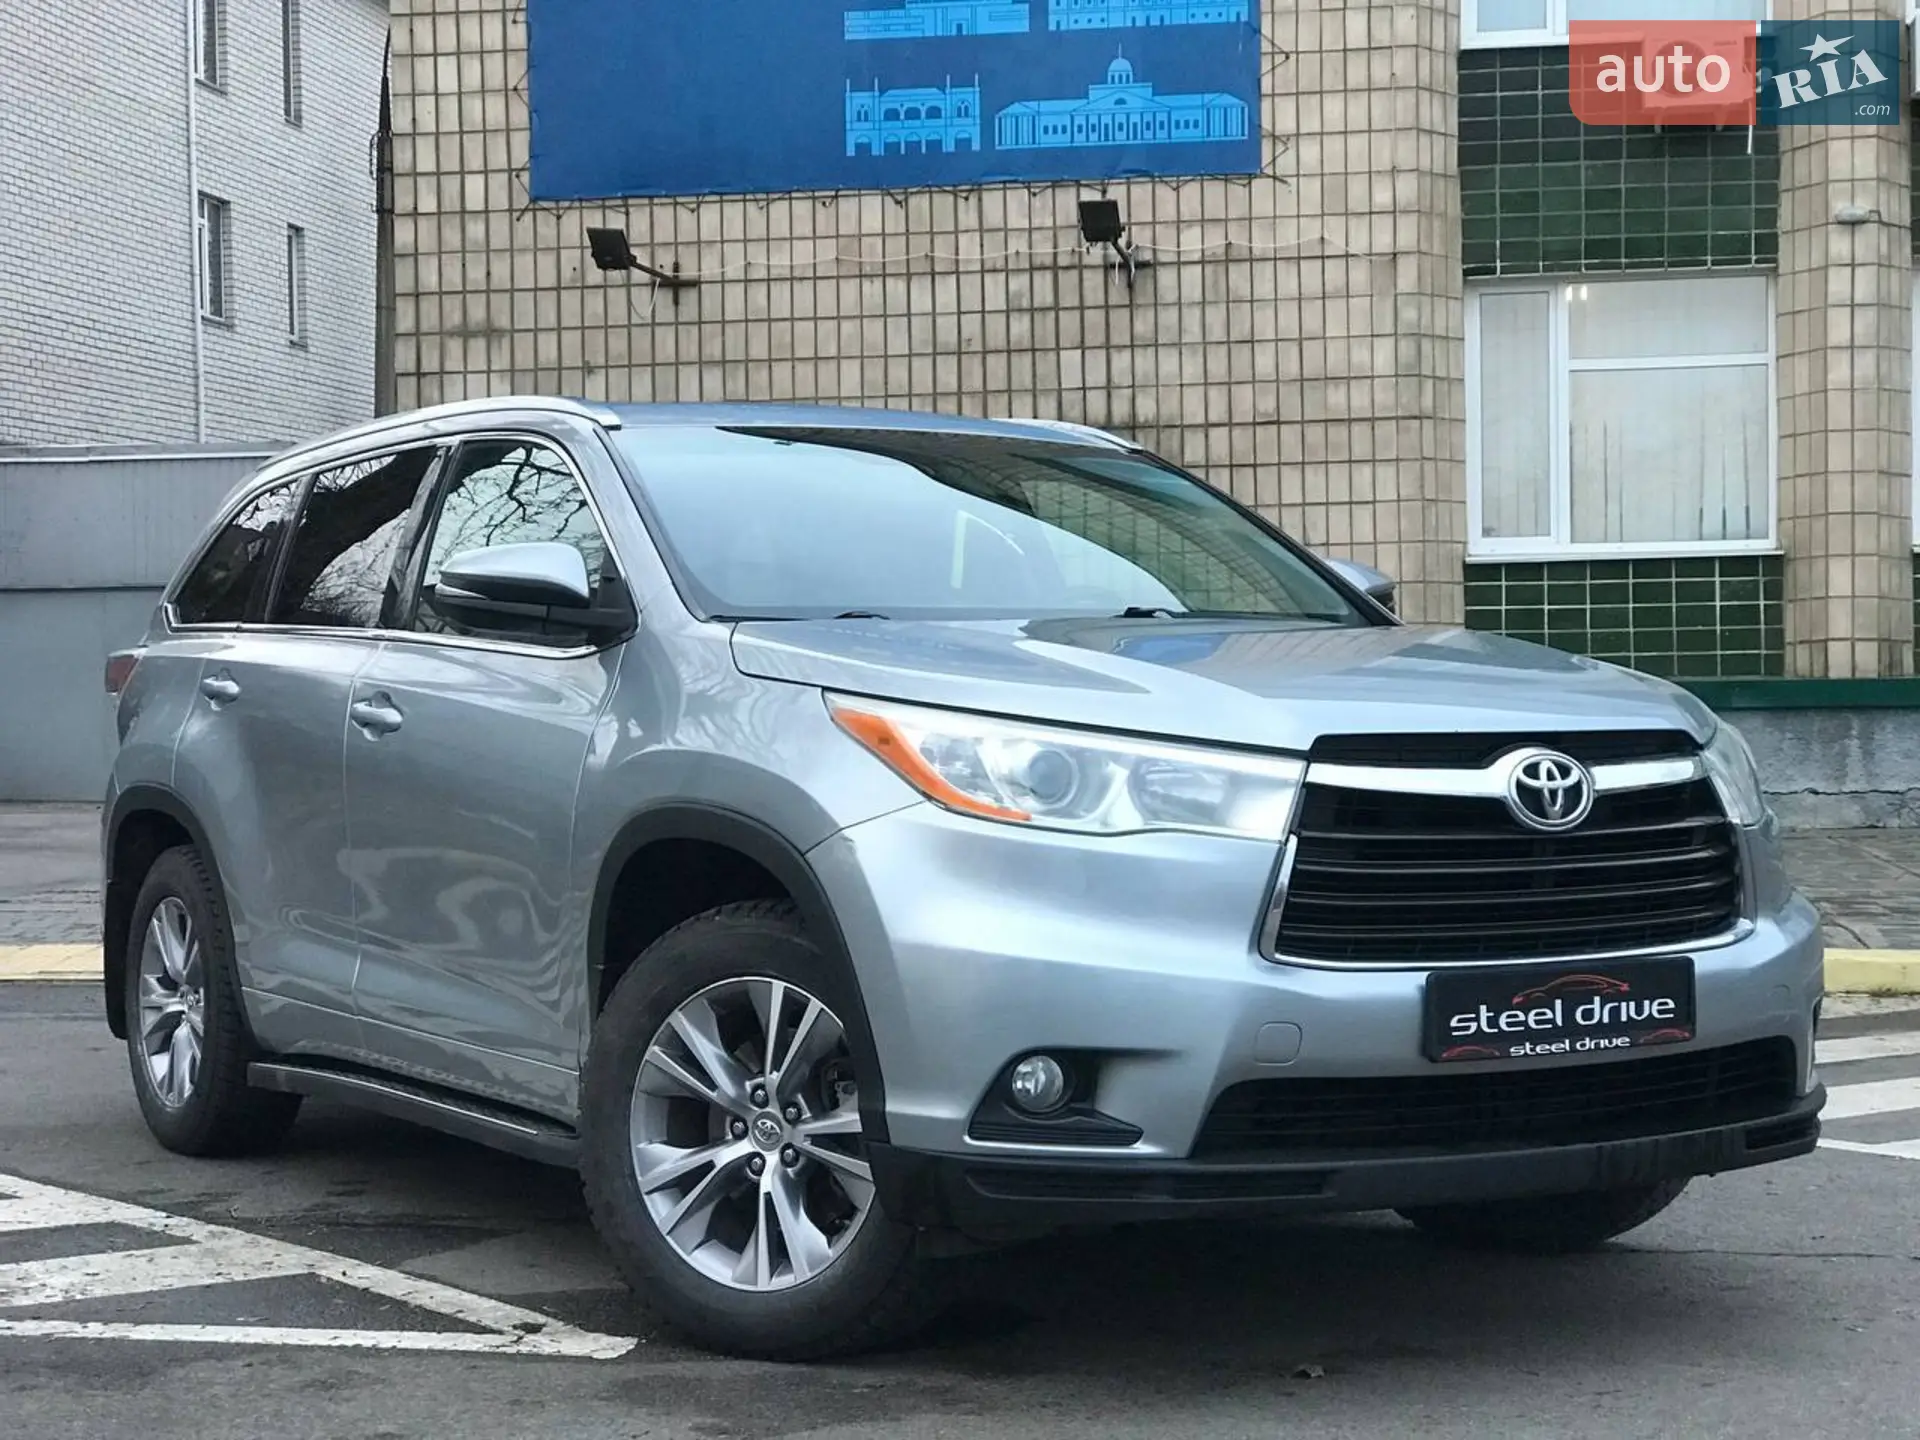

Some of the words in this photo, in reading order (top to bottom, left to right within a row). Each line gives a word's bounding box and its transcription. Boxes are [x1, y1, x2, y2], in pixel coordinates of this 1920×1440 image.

[1449, 998, 1563, 1036] steel
[1574, 995, 1676, 1026] drive
[1509, 1040, 1571, 1057] steel
[1575, 1035, 1631, 1051] drive
